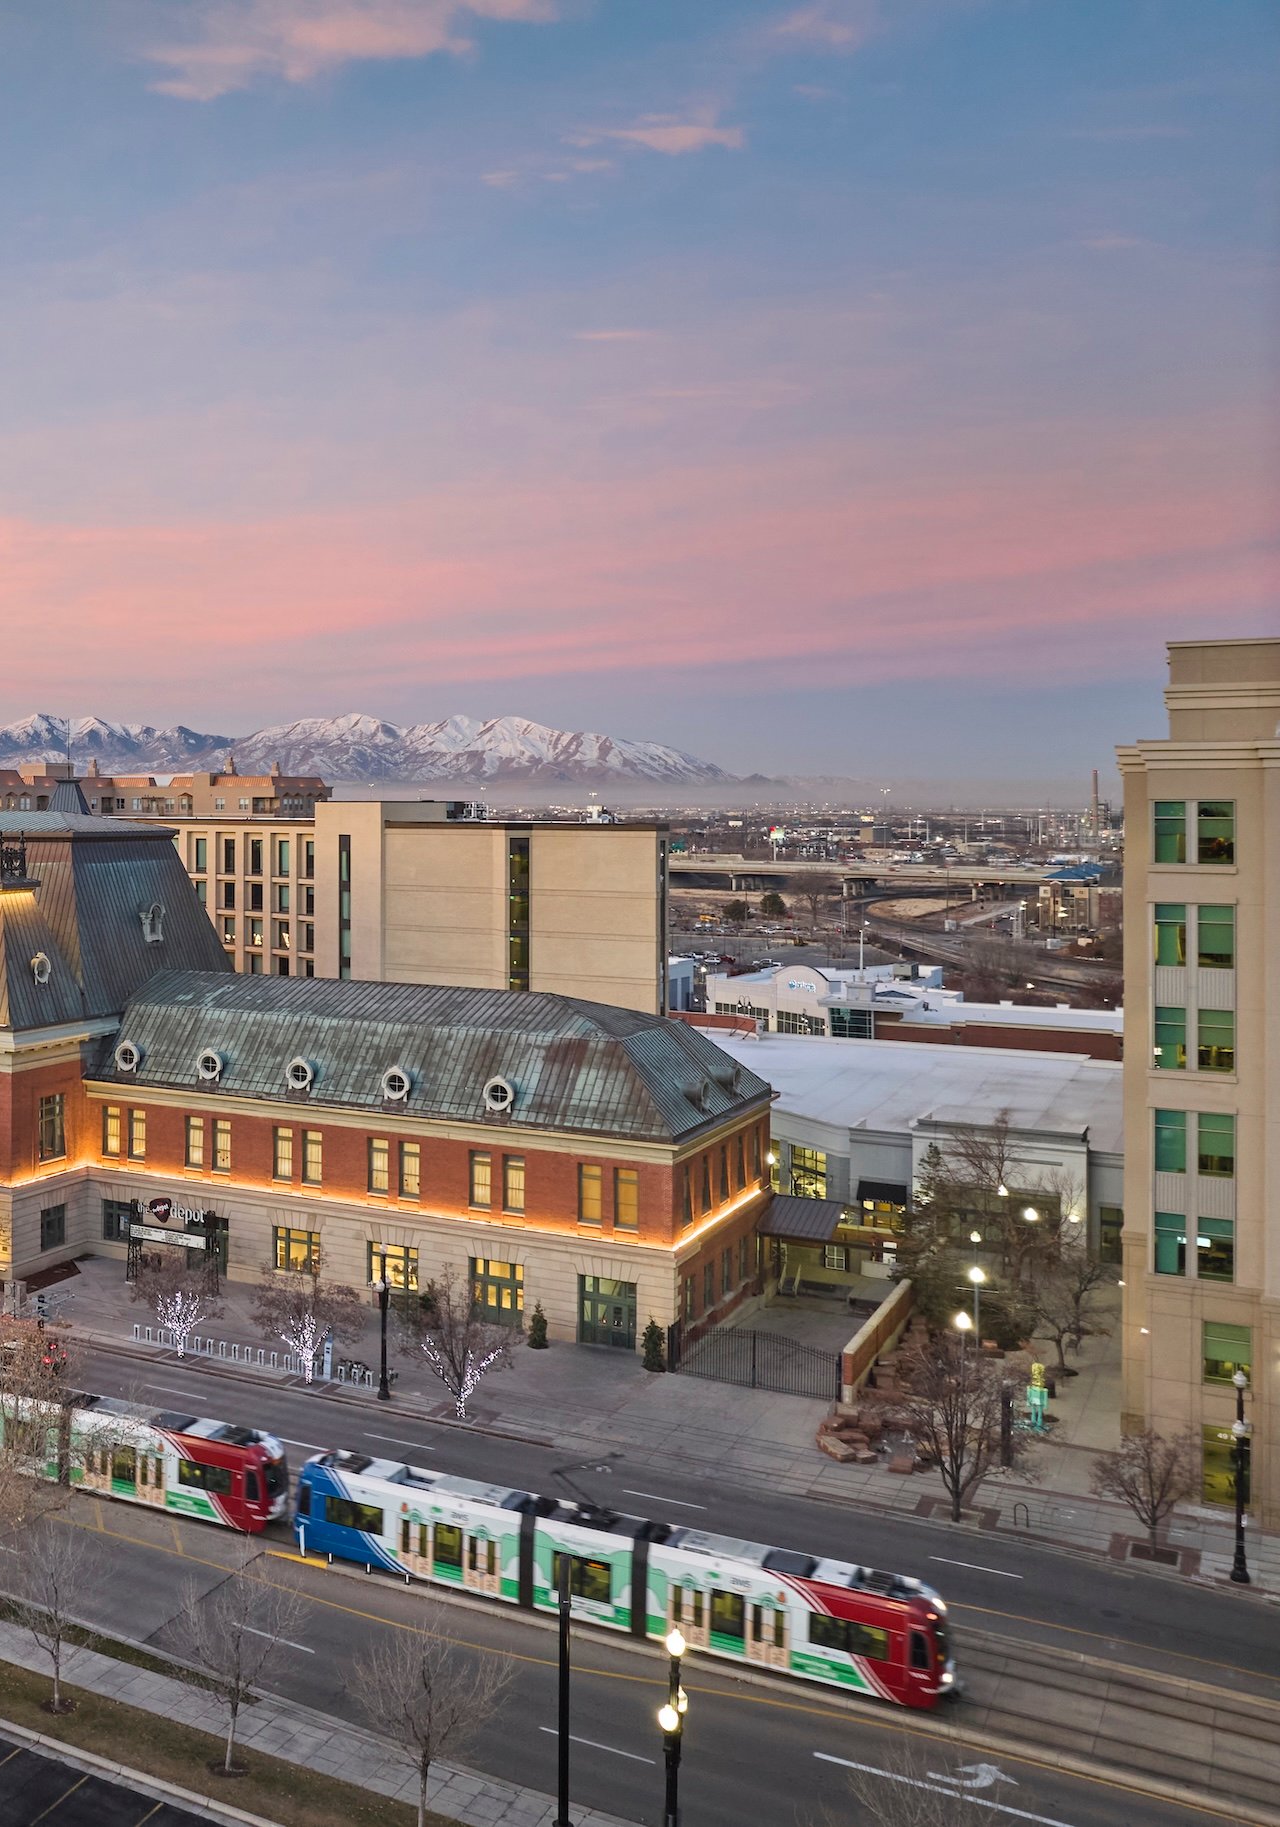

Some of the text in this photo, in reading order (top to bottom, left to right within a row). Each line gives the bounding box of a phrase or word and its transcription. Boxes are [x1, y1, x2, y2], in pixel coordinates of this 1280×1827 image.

[137, 1201, 205, 1224] the depot
[730, 1577, 752, 1588] aws
